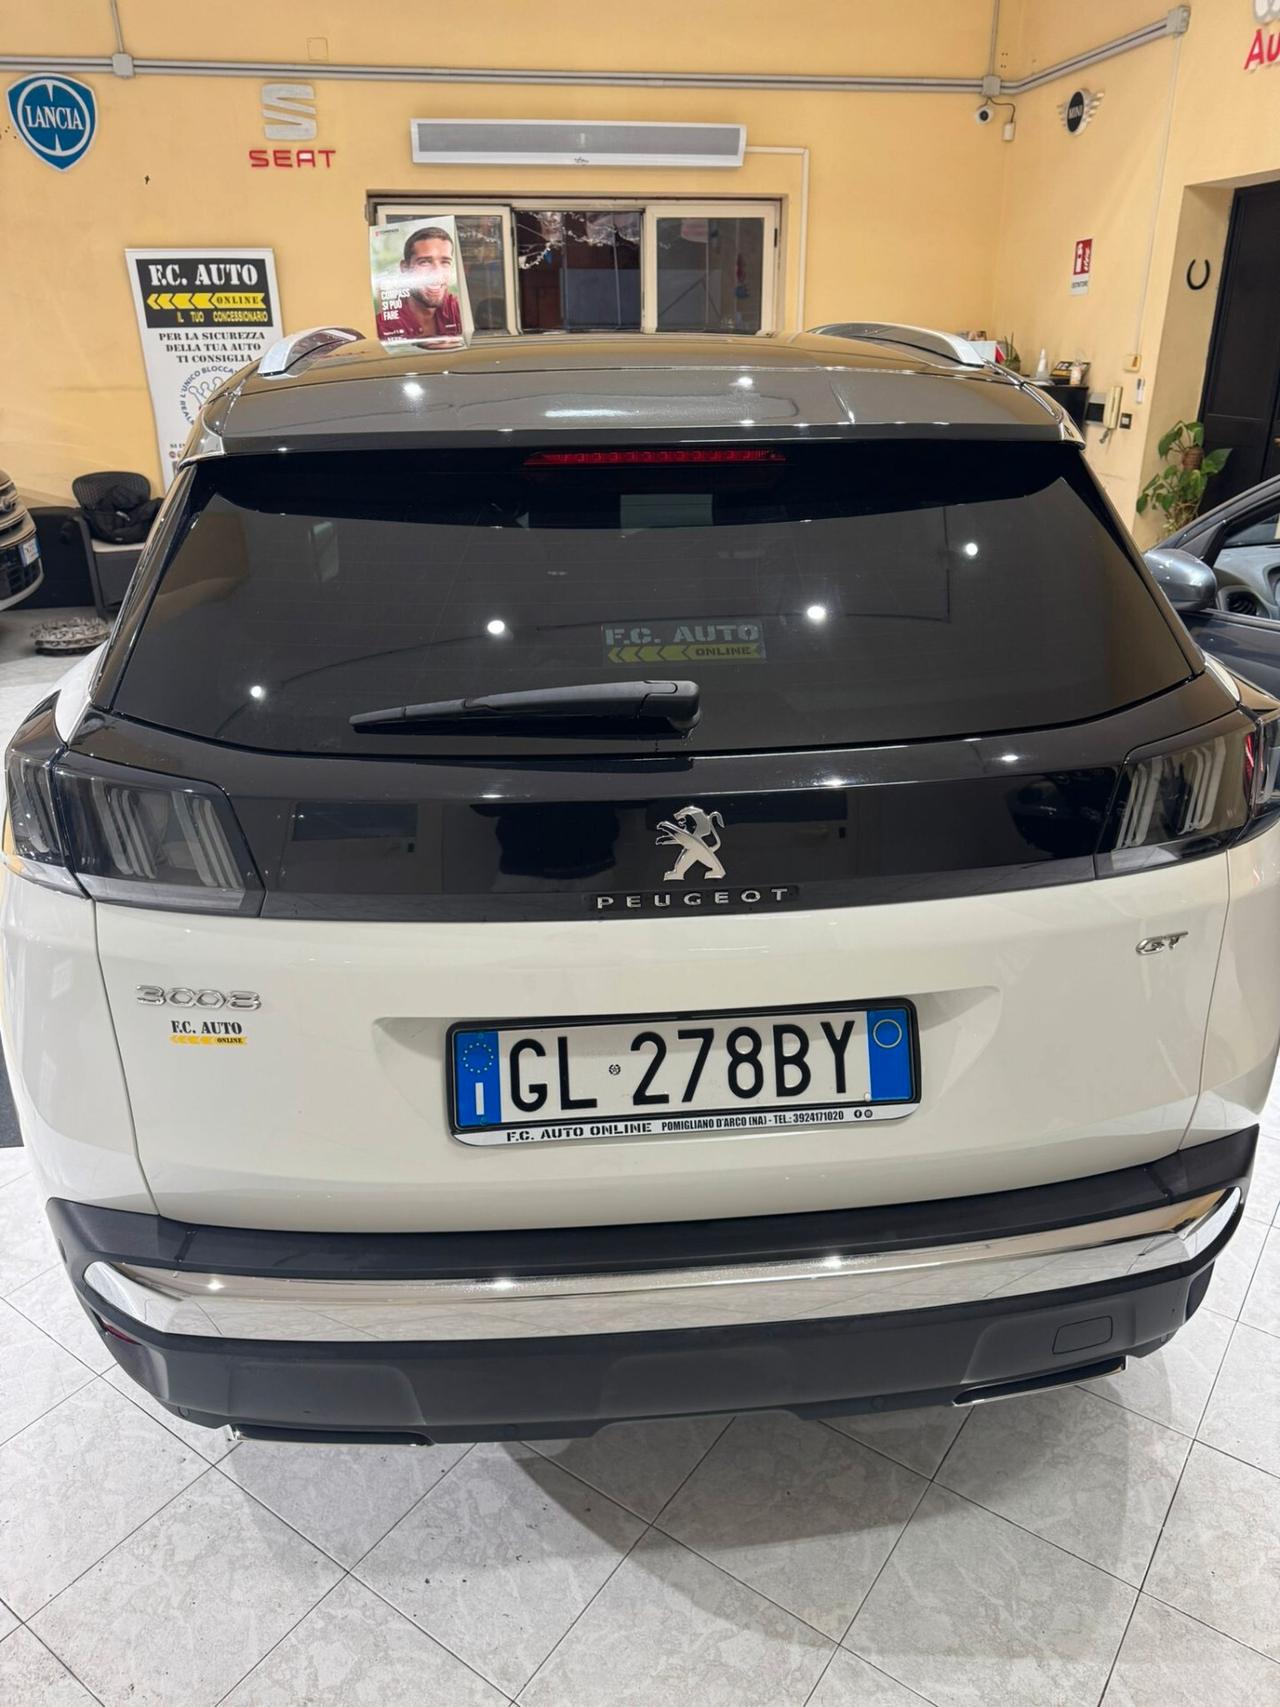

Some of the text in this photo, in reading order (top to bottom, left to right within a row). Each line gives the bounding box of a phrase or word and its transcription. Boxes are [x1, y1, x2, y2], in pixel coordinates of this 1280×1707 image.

[24, 105, 84, 130] LANCIA
[249, 150, 336, 168] SEAT
[148, 264, 258, 286] F.C. AUTO
[216, 296, 259, 305] ONLINE
[190, 311, 205, 323] TUO
[213, 311, 268, 322] CONCESSIONARIO
[159, 331, 265, 341] PER LA SICUREZZA
[166, 343, 261, 352] DELLA TUA AUTO
[192, 354, 253, 363] CONSIGLIA
[605, 624, 760, 646] F.C. AUTO
[695, 646, 752, 657] ONLINE
[596, 888, 788, 909] PEUGEOT
[1136, 931, 1189, 956] GT
[136, 985, 262, 1011] 3008
[171, 1020, 242, 1035] F.C. AUTO
[509, 1036, 598, 1113] GL
[630, 1020, 856, 1106] 278BY
[506, 1131, 535, 1142] F.C.
[540, 1127, 584, 1139] AUTO
[590, 1122, 652, 1136] ONLINE
[661, 1119, 715, 1131] POMIGLIANO
[716, 1116, 747, 1127] D'ARCO
[793, 1111, 844, 1123] 3924171020
